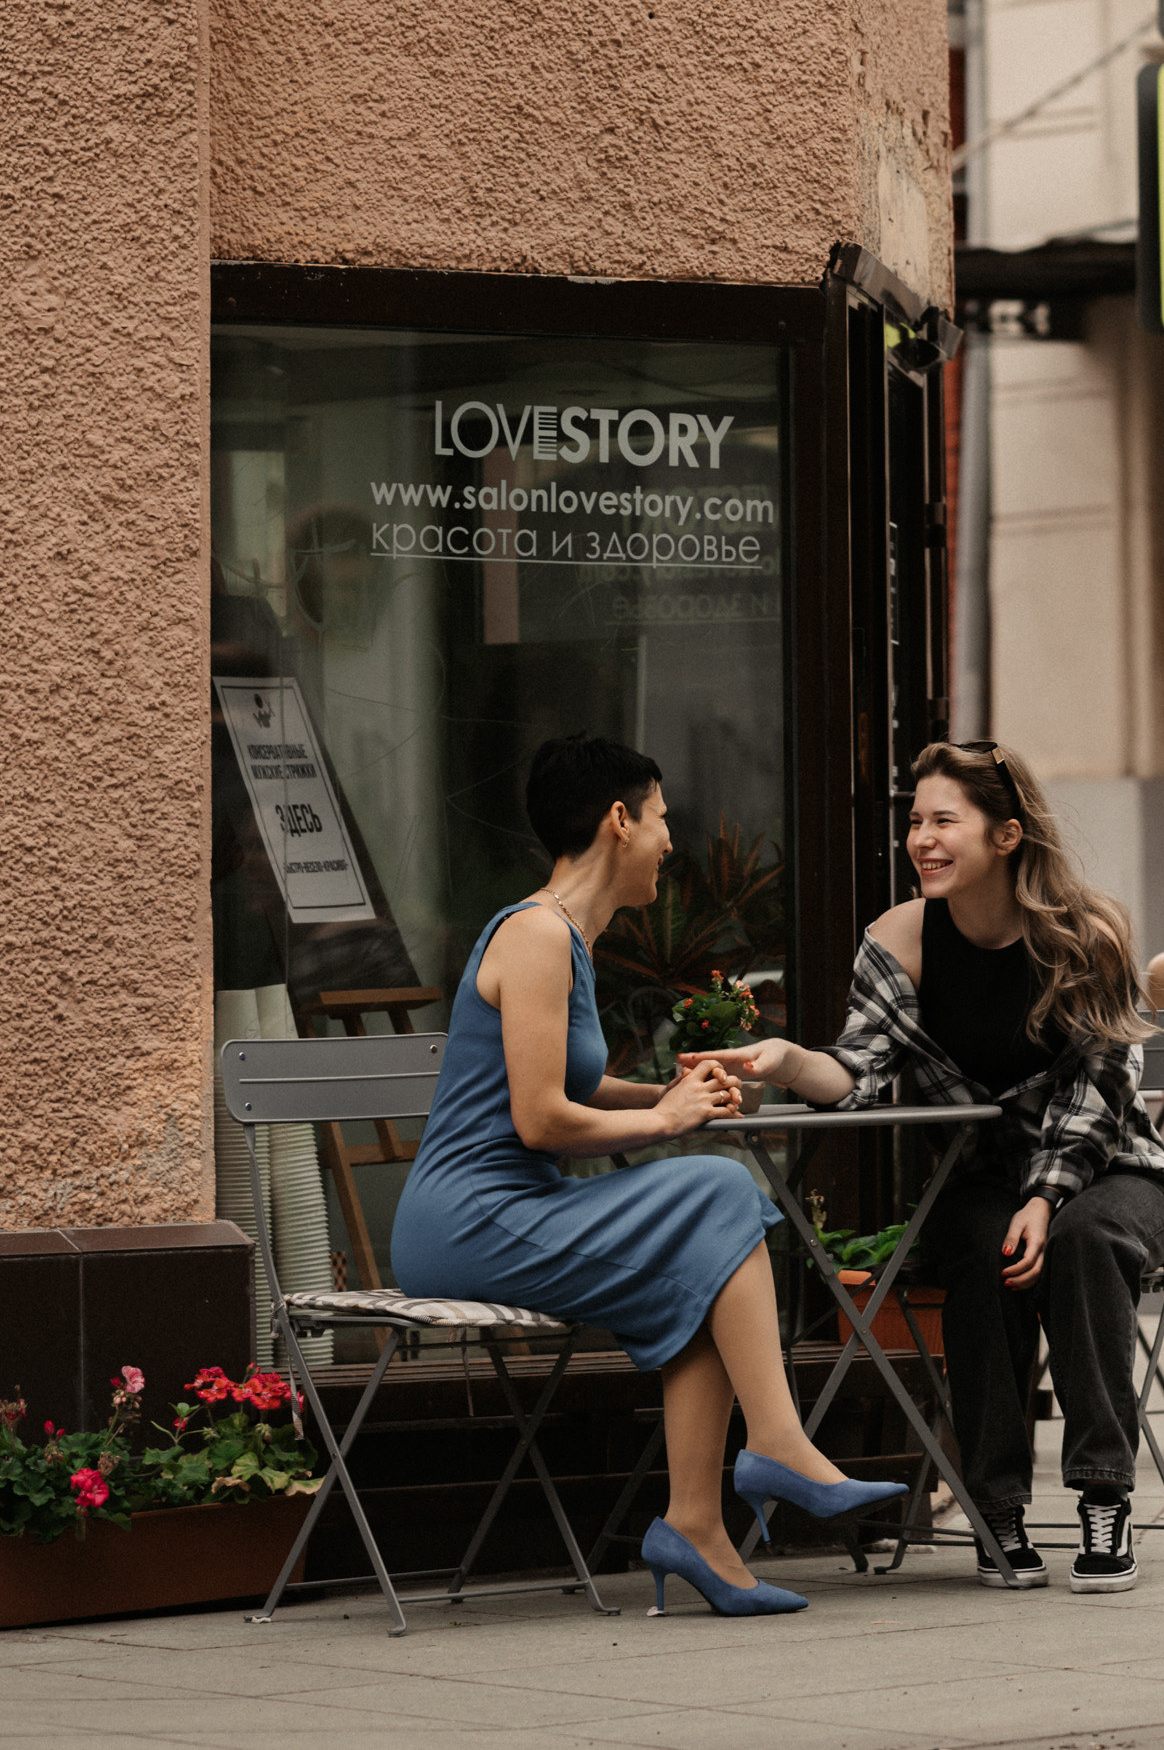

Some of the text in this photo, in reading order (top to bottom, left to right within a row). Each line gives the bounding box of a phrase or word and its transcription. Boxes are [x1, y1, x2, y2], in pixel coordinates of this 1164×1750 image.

[434, 400, 735, 469] LOVESTORY
[370, 479, 775, 526] www.salonlovestory.com
[372, 522, 761, 568] красота и здоровье
[275, 804, 322, 837] ЗДЕСЬ
